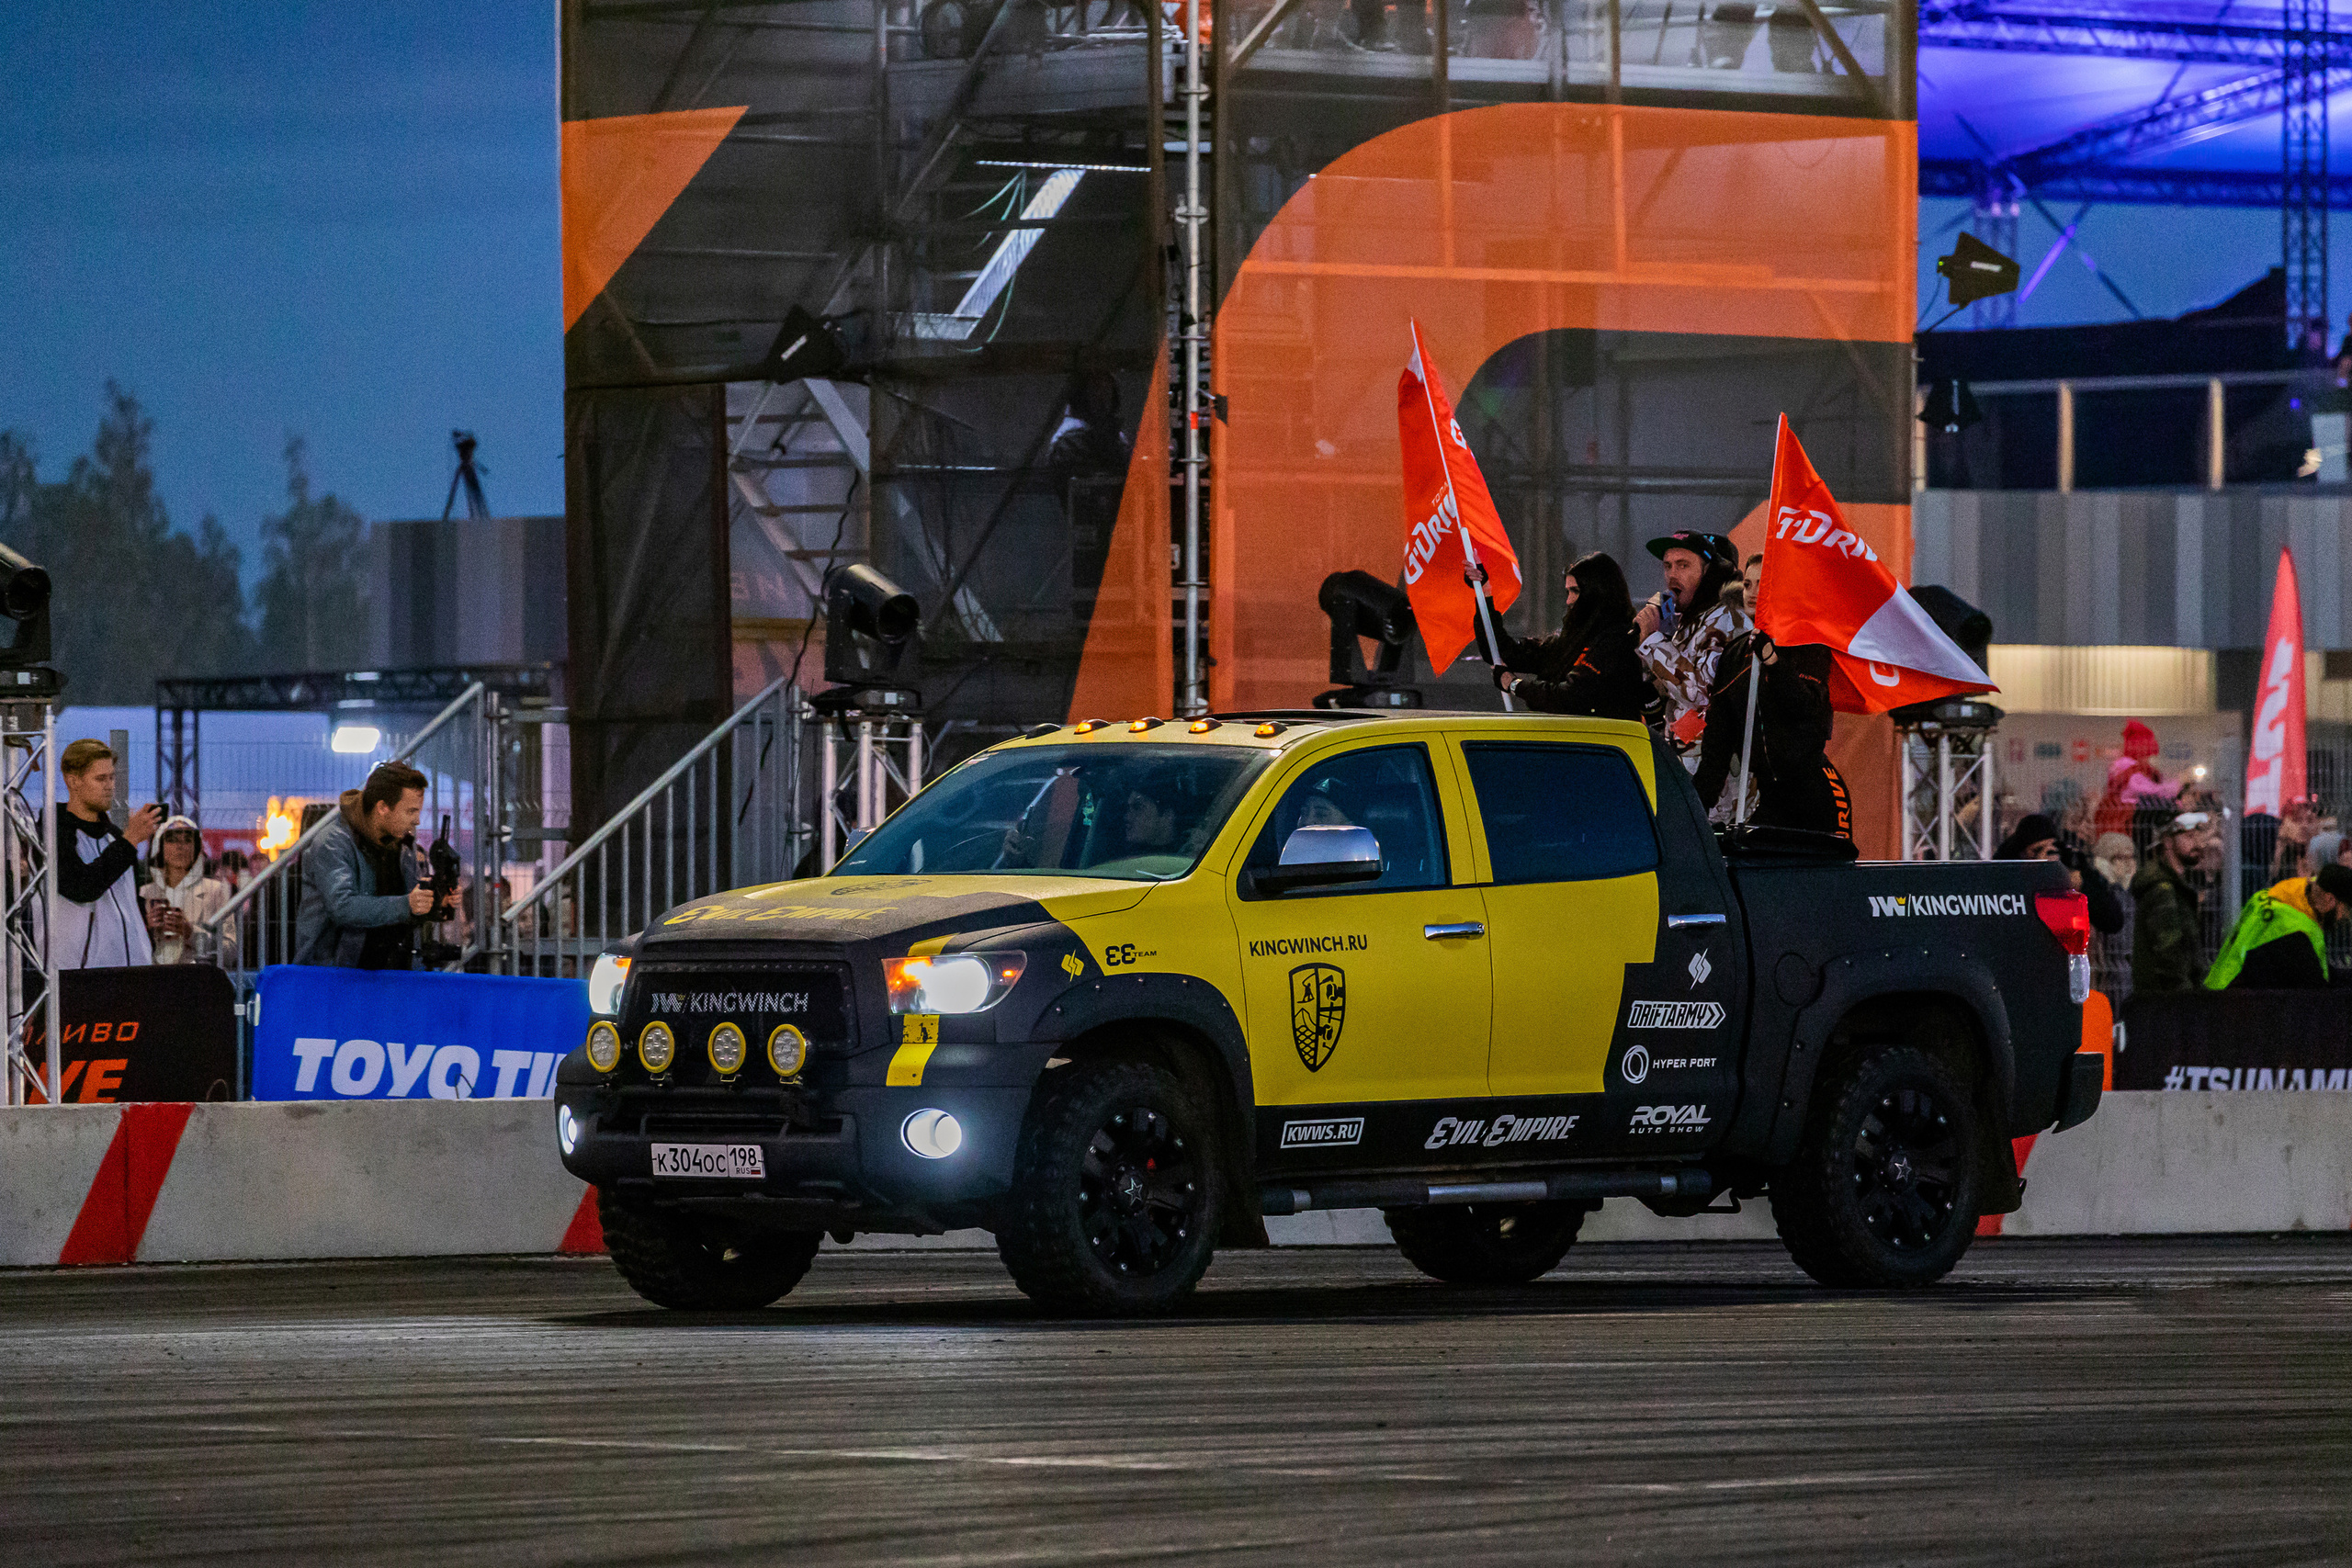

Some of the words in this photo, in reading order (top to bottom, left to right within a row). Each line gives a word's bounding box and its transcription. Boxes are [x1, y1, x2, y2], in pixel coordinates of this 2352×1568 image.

[1912, 894, 2027, 916] KINGWINCH
[1250, 934, 1368, 957] KINGWINCH.RU
[690, 992, 809, 1012] KINGWINCH
[1628, 1000, 1710, 1028] DRIFTARMY
[292, 1037, 481, 1099] TOYO
[1653, 1058, 1687, 1068] HYPER
[1690, 1057, 1717, 1067] PORT
[1630, 1104, 1712, 1125] ROYAL
[1287, 1122, 1359, 1142] KWWS.RU
[729, 1147, 757, 1167] 198
